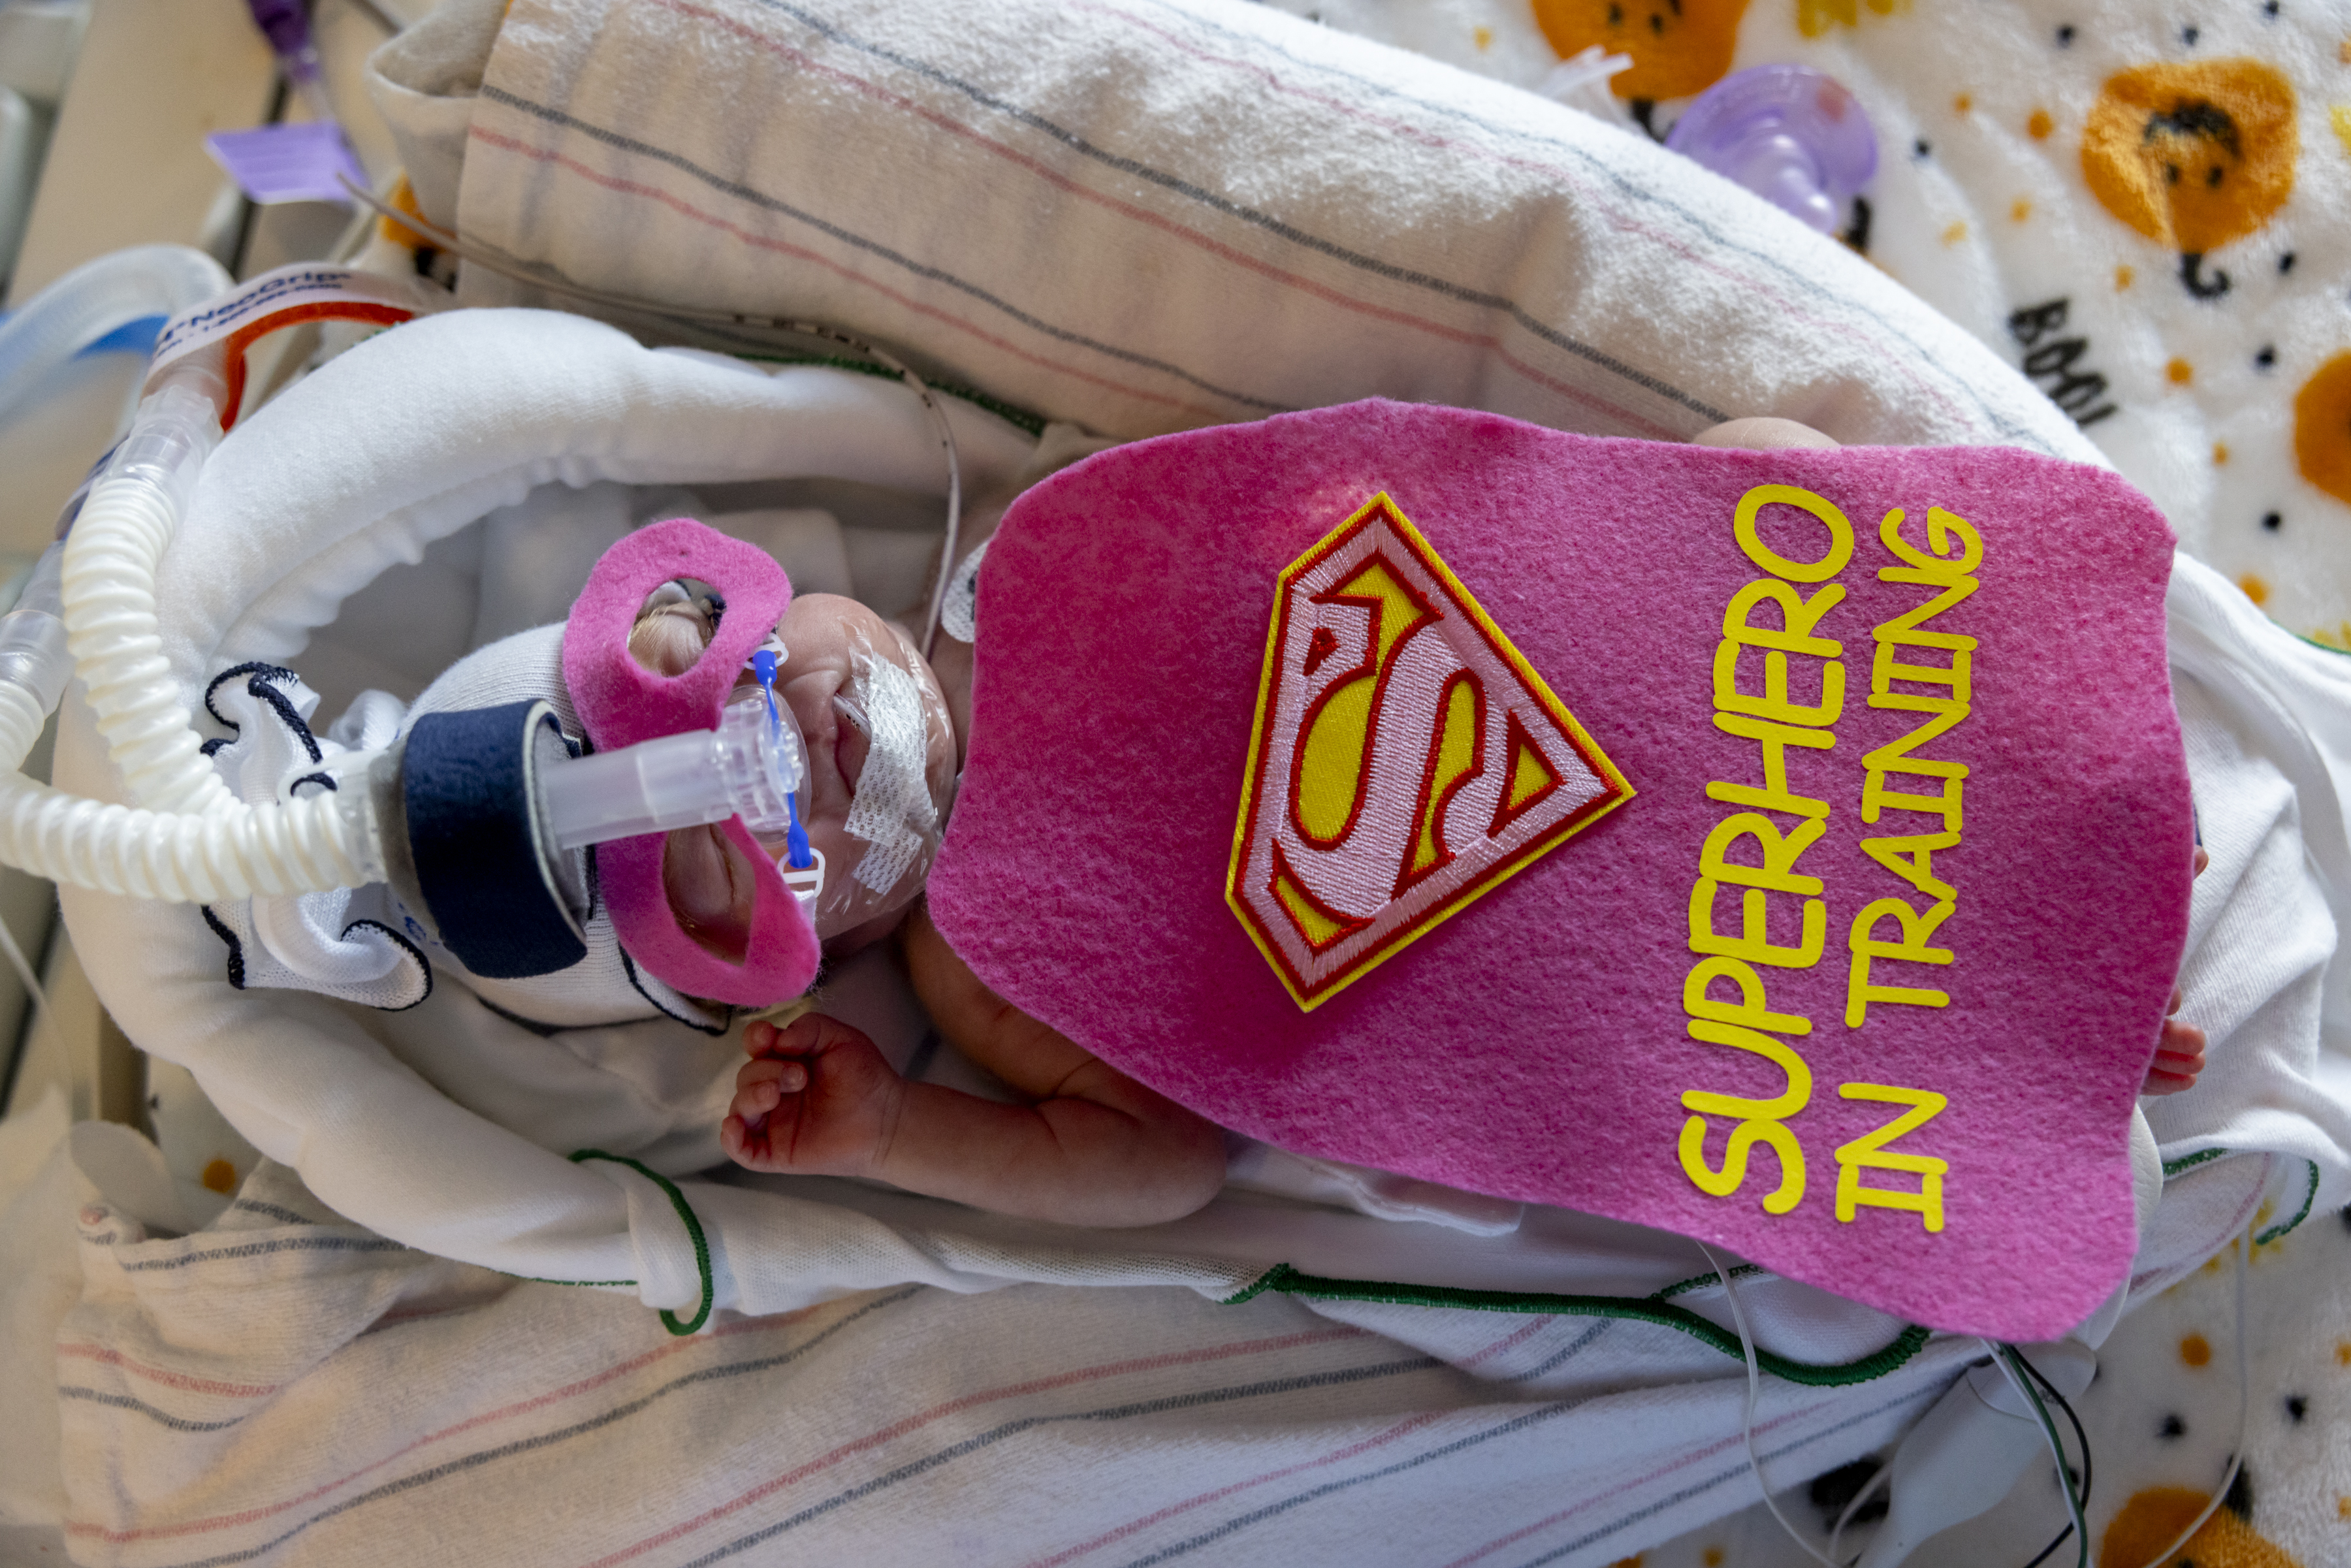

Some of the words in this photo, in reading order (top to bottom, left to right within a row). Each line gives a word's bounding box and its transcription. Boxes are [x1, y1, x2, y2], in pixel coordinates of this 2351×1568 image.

[2006, 297, 2118, 428] BOO!
[1678, 484, 1855, 1215] SUPERHERO
[1844, 506, 1983, 1028] TRAINING
[1834, 1083, 1949, 1232] IN
